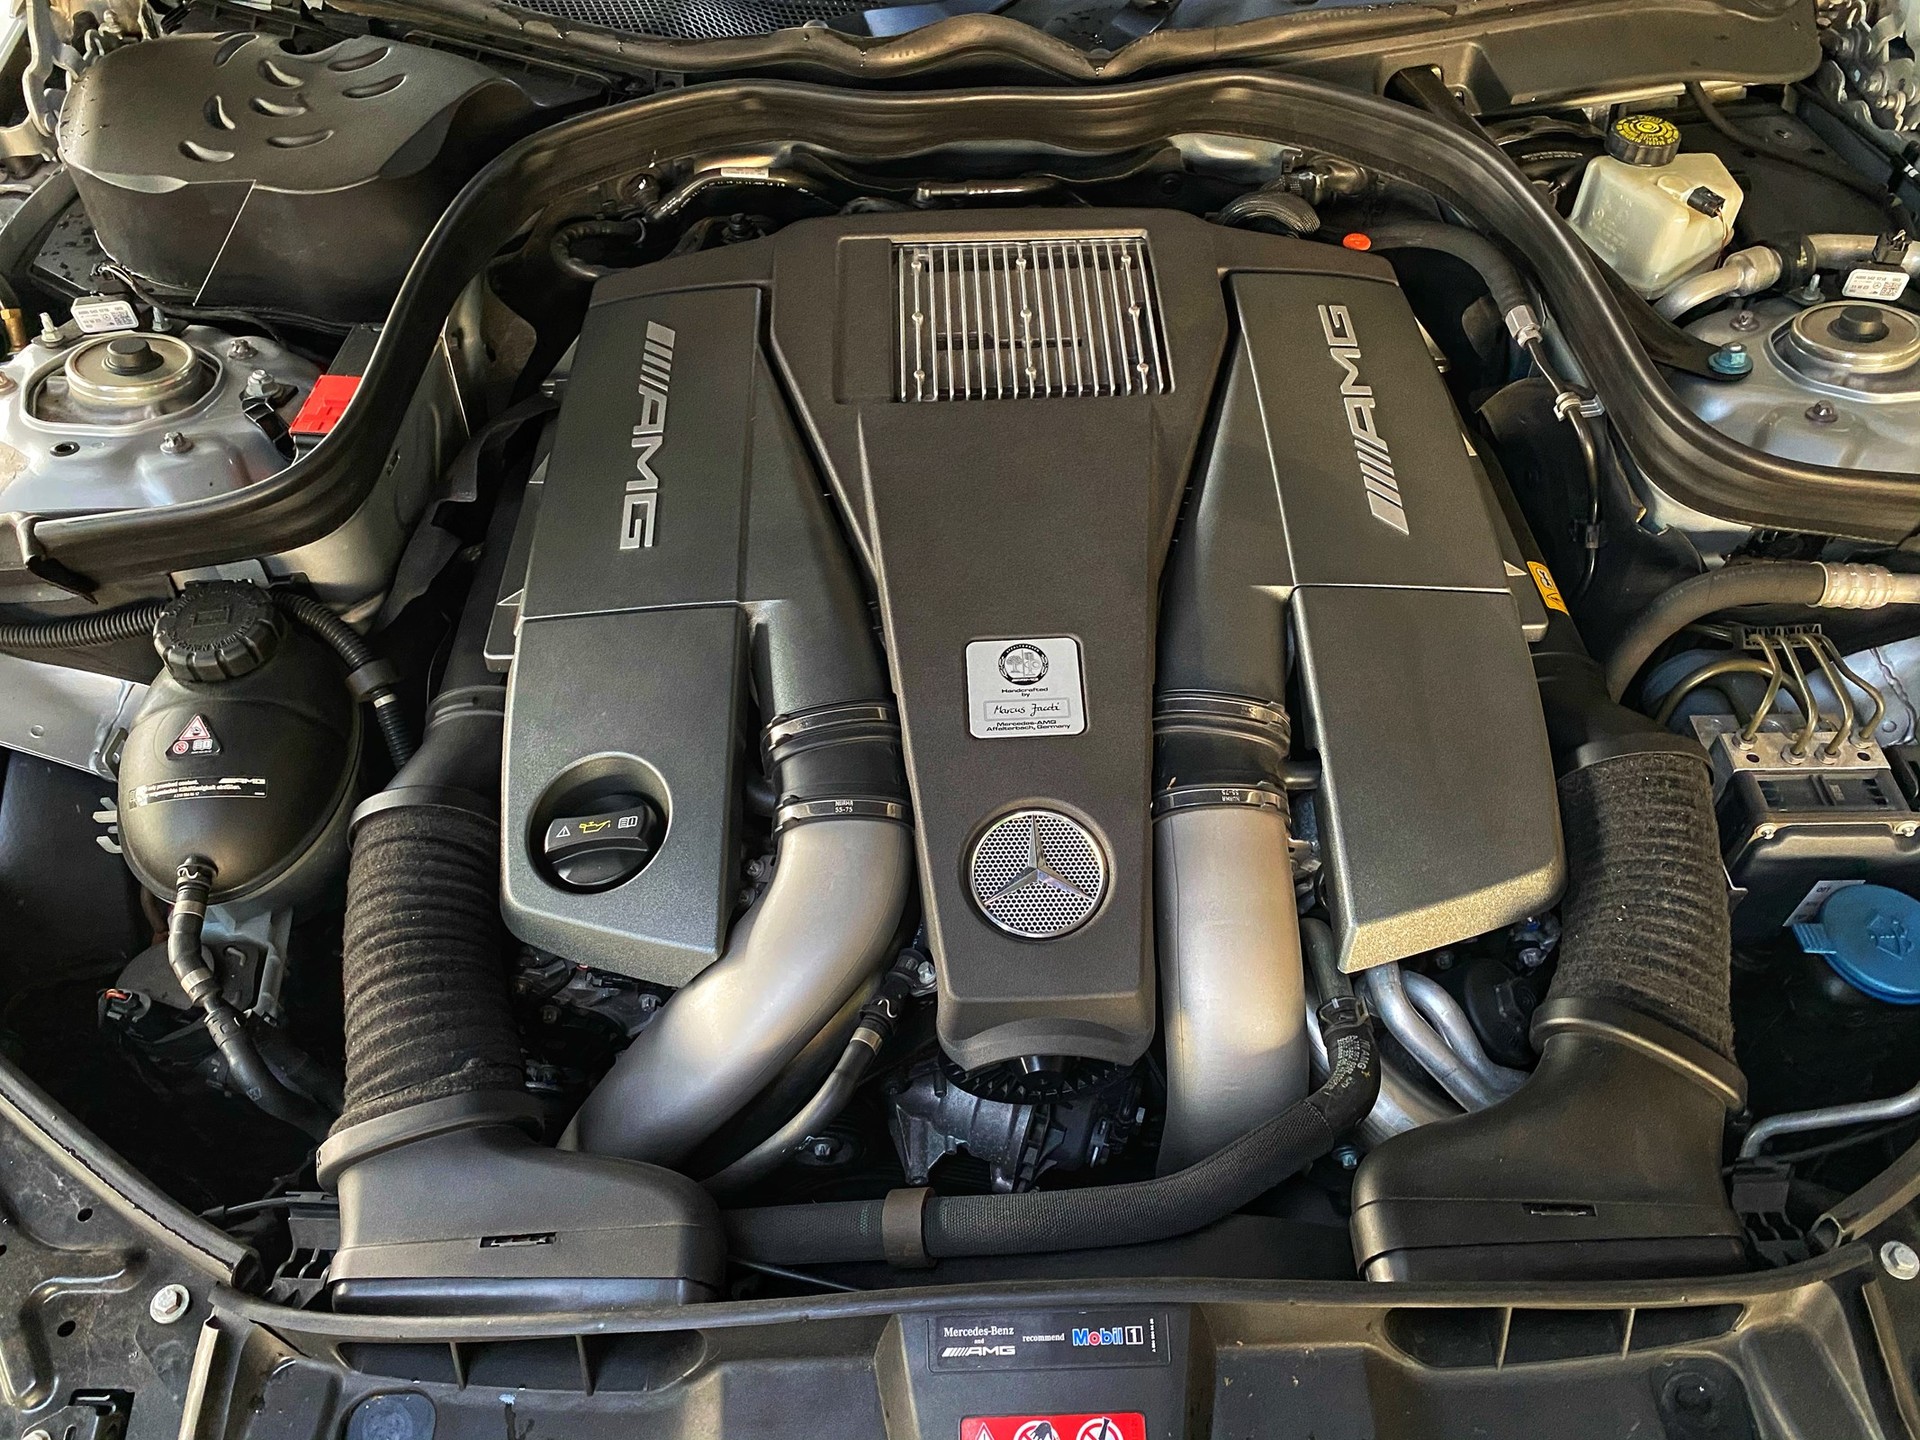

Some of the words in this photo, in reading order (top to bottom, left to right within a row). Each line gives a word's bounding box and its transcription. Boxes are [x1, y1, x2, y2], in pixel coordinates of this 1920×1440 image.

[1318, 304, 1388, 454] AMG
[619, 383, 668, 550] AMG
[994, 704, 1026, 715] Marcus
[996, 719, 1057, 727] Mercedes-AMG
[943, 1325, 1015, 1338] Mercedes-Benz
[1022, 1333, 1065, 1342] recommend
[1072, 1327, 1124, 1346] Mobil
[964, 1345, 1016, 1356] AMG
